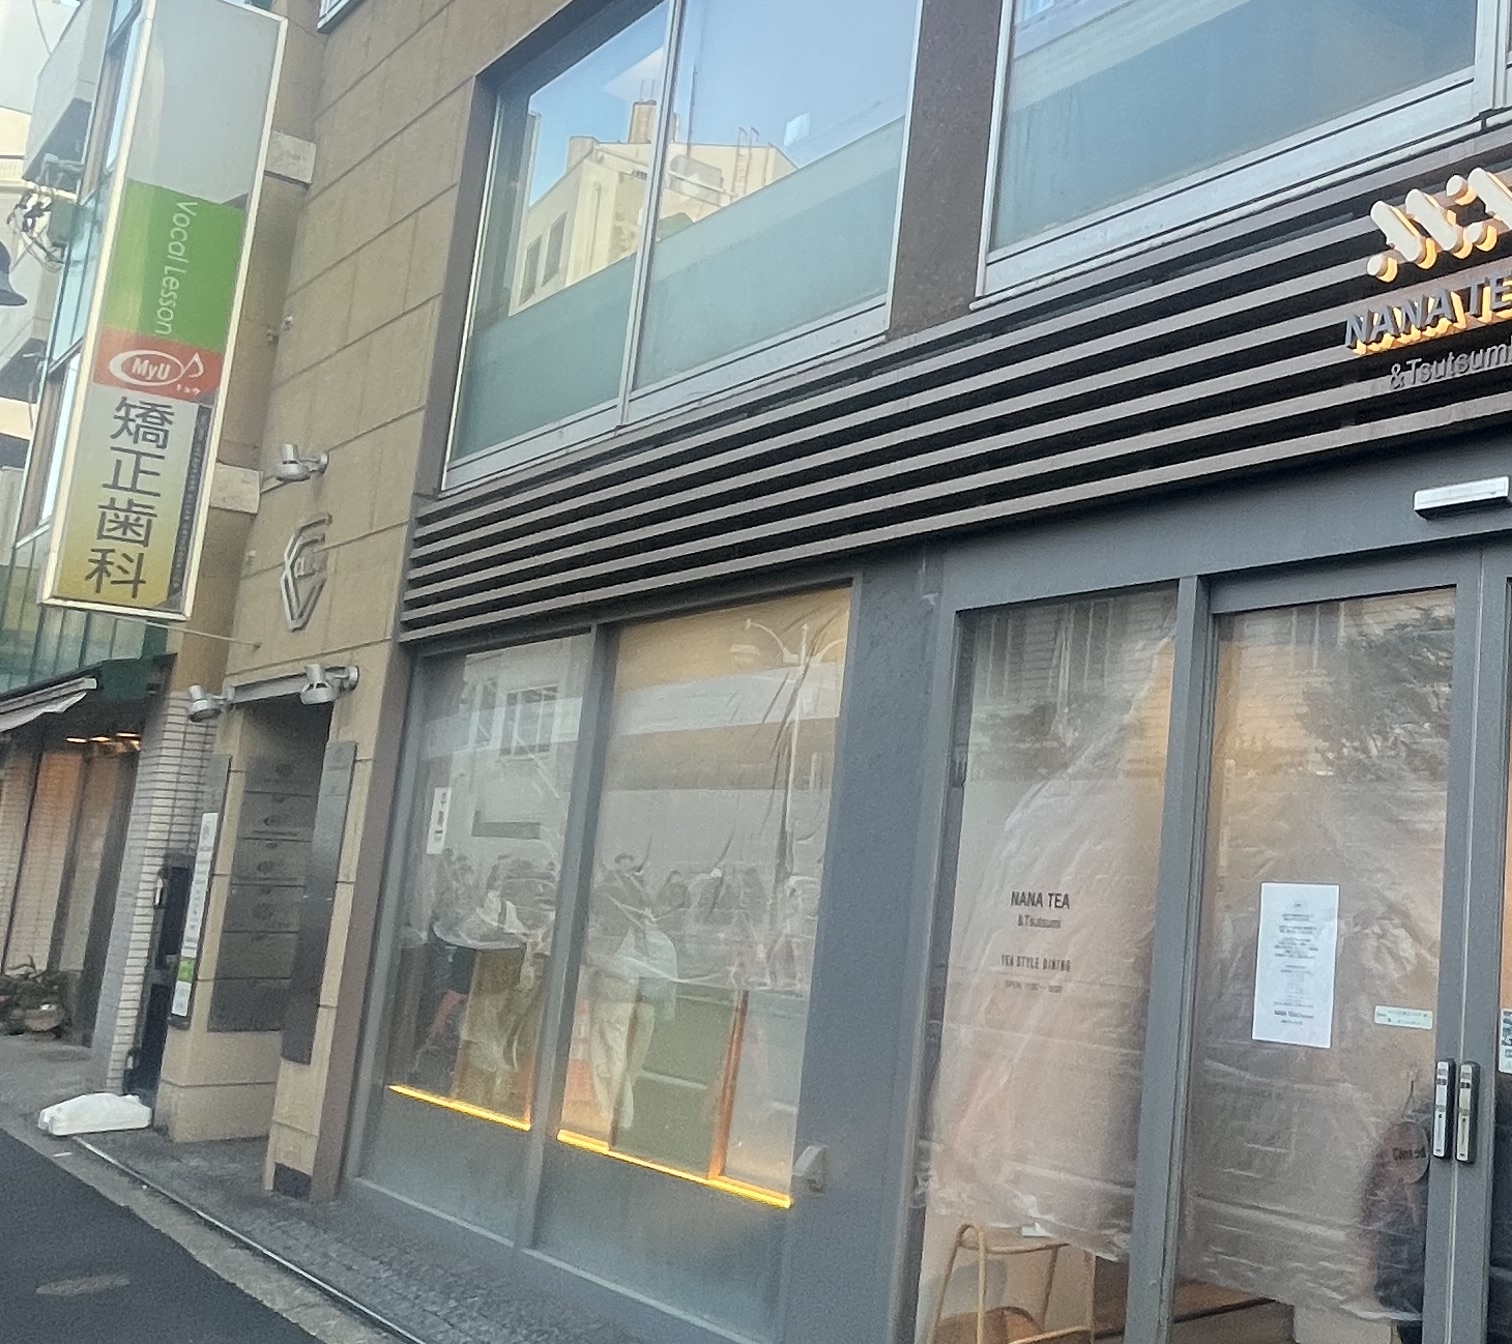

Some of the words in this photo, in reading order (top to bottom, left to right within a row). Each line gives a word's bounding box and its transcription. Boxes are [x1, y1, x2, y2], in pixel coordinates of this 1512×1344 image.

[166, 201, 199, 264] Vocal
[154, 265, 188, 335] Lesson
[1344, 287, 1462, 350] NANA
[132, 357, 171, 381] MyU
[84, 396, 175, 599] 矯正歯科
[1010, 890, 1044, 908] NANA
[1047, 892, 1071, 910] TEA
